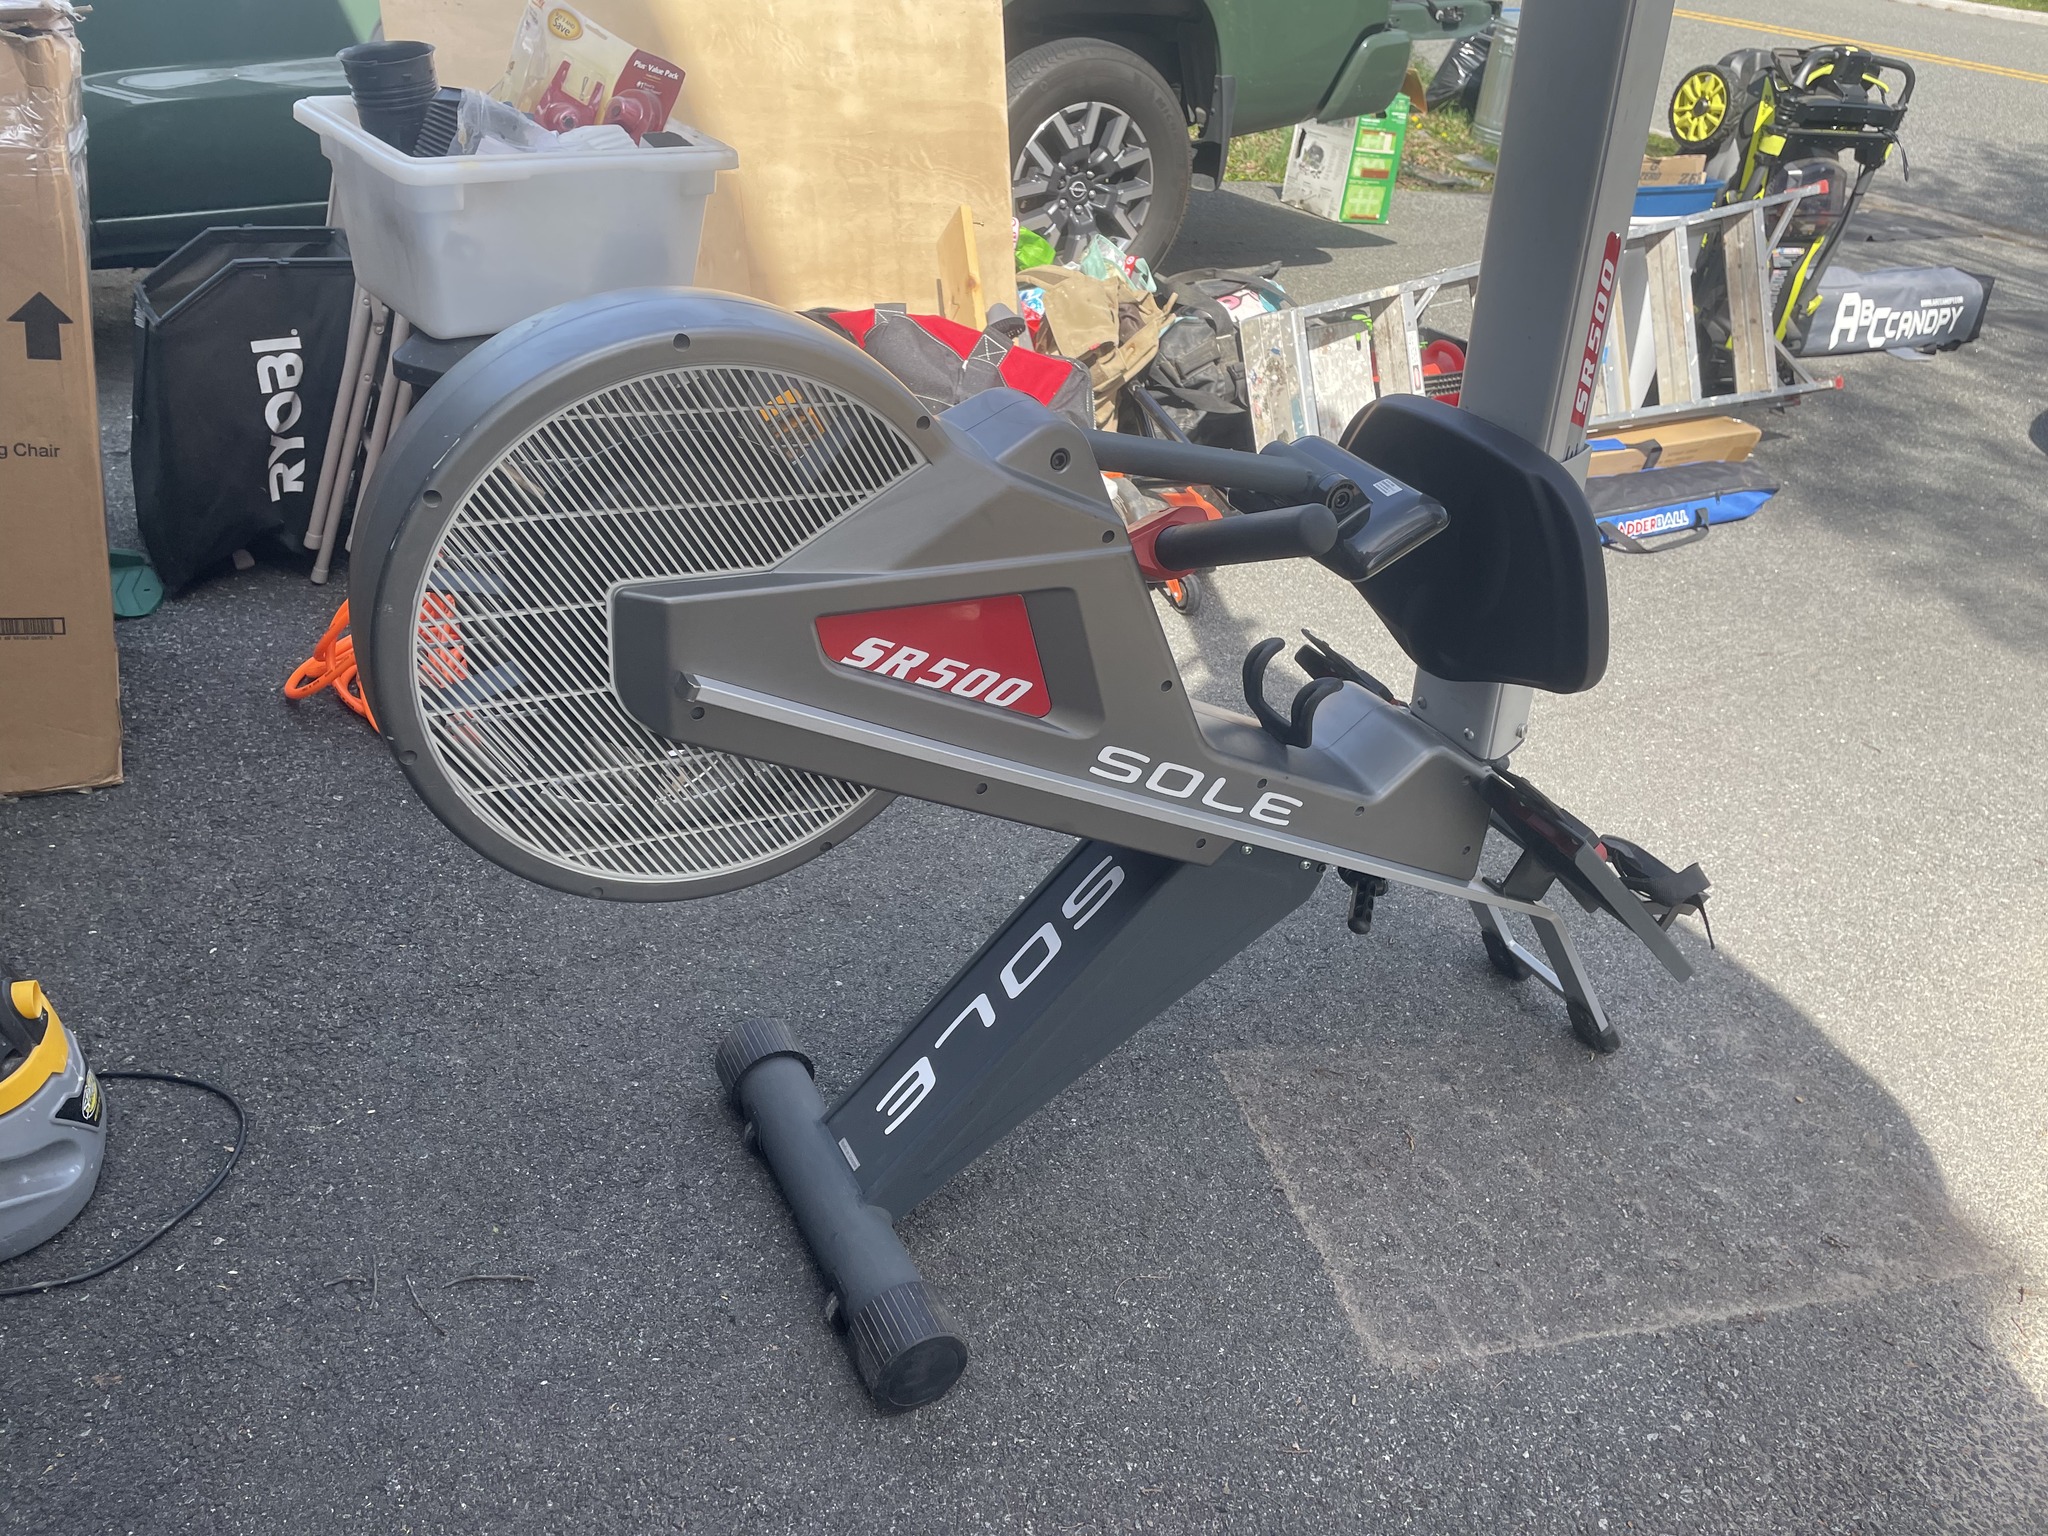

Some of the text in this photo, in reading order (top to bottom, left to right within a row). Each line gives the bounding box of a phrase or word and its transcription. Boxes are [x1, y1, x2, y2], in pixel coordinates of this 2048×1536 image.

[552, 17, 571, 37] Save
[633, 59, 647, 70] Plus
[648, 64, 664, 76] Value
[664, 69, 679, 80] Pack
[1575, 257, 1615, 416] SR500
[13, 442, 61, 458] Chair
[250, 335, 306, 503] RYOBI
[1617, 509, 1690, 537] ADDERBALL
[840, 636, 1034, 707] SR500
[1088, 745, 1304, 826] SOLE
[875, 855, 1126, 1136] SOLE
